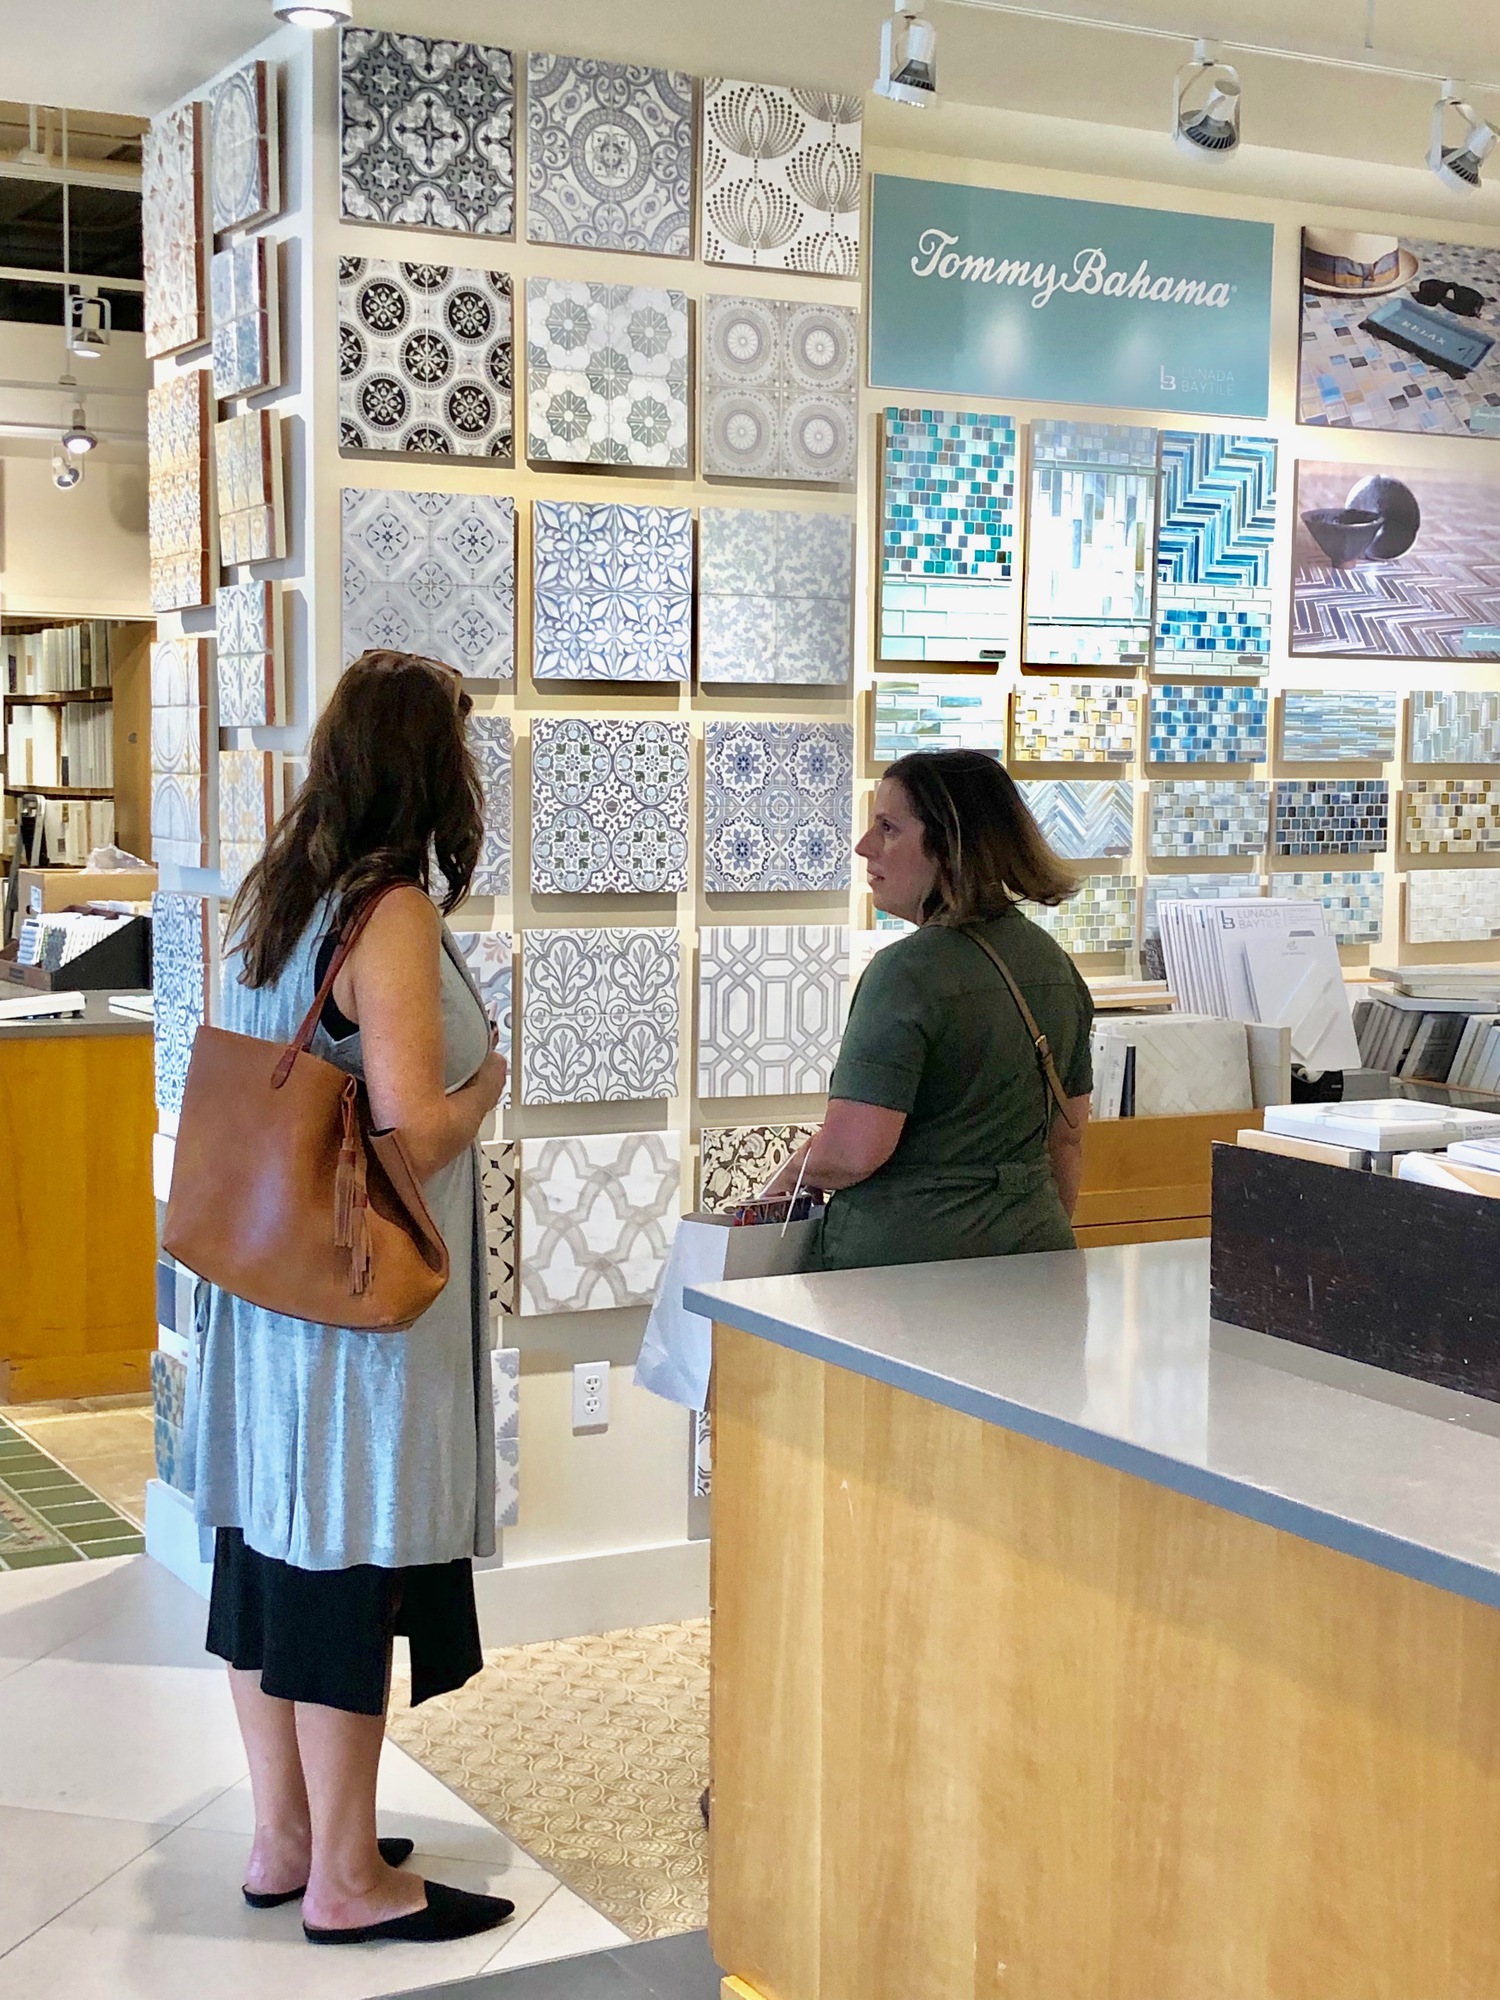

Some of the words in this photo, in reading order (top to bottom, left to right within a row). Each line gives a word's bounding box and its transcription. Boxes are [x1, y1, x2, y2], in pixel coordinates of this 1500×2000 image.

[911, 228, 1062, 309] Tommy
[1060, 248, 1232, 309] Bahama
[1181, 366, 1235, 383] LUNADA
[1237, 908, 1281, 919] LUNADA
